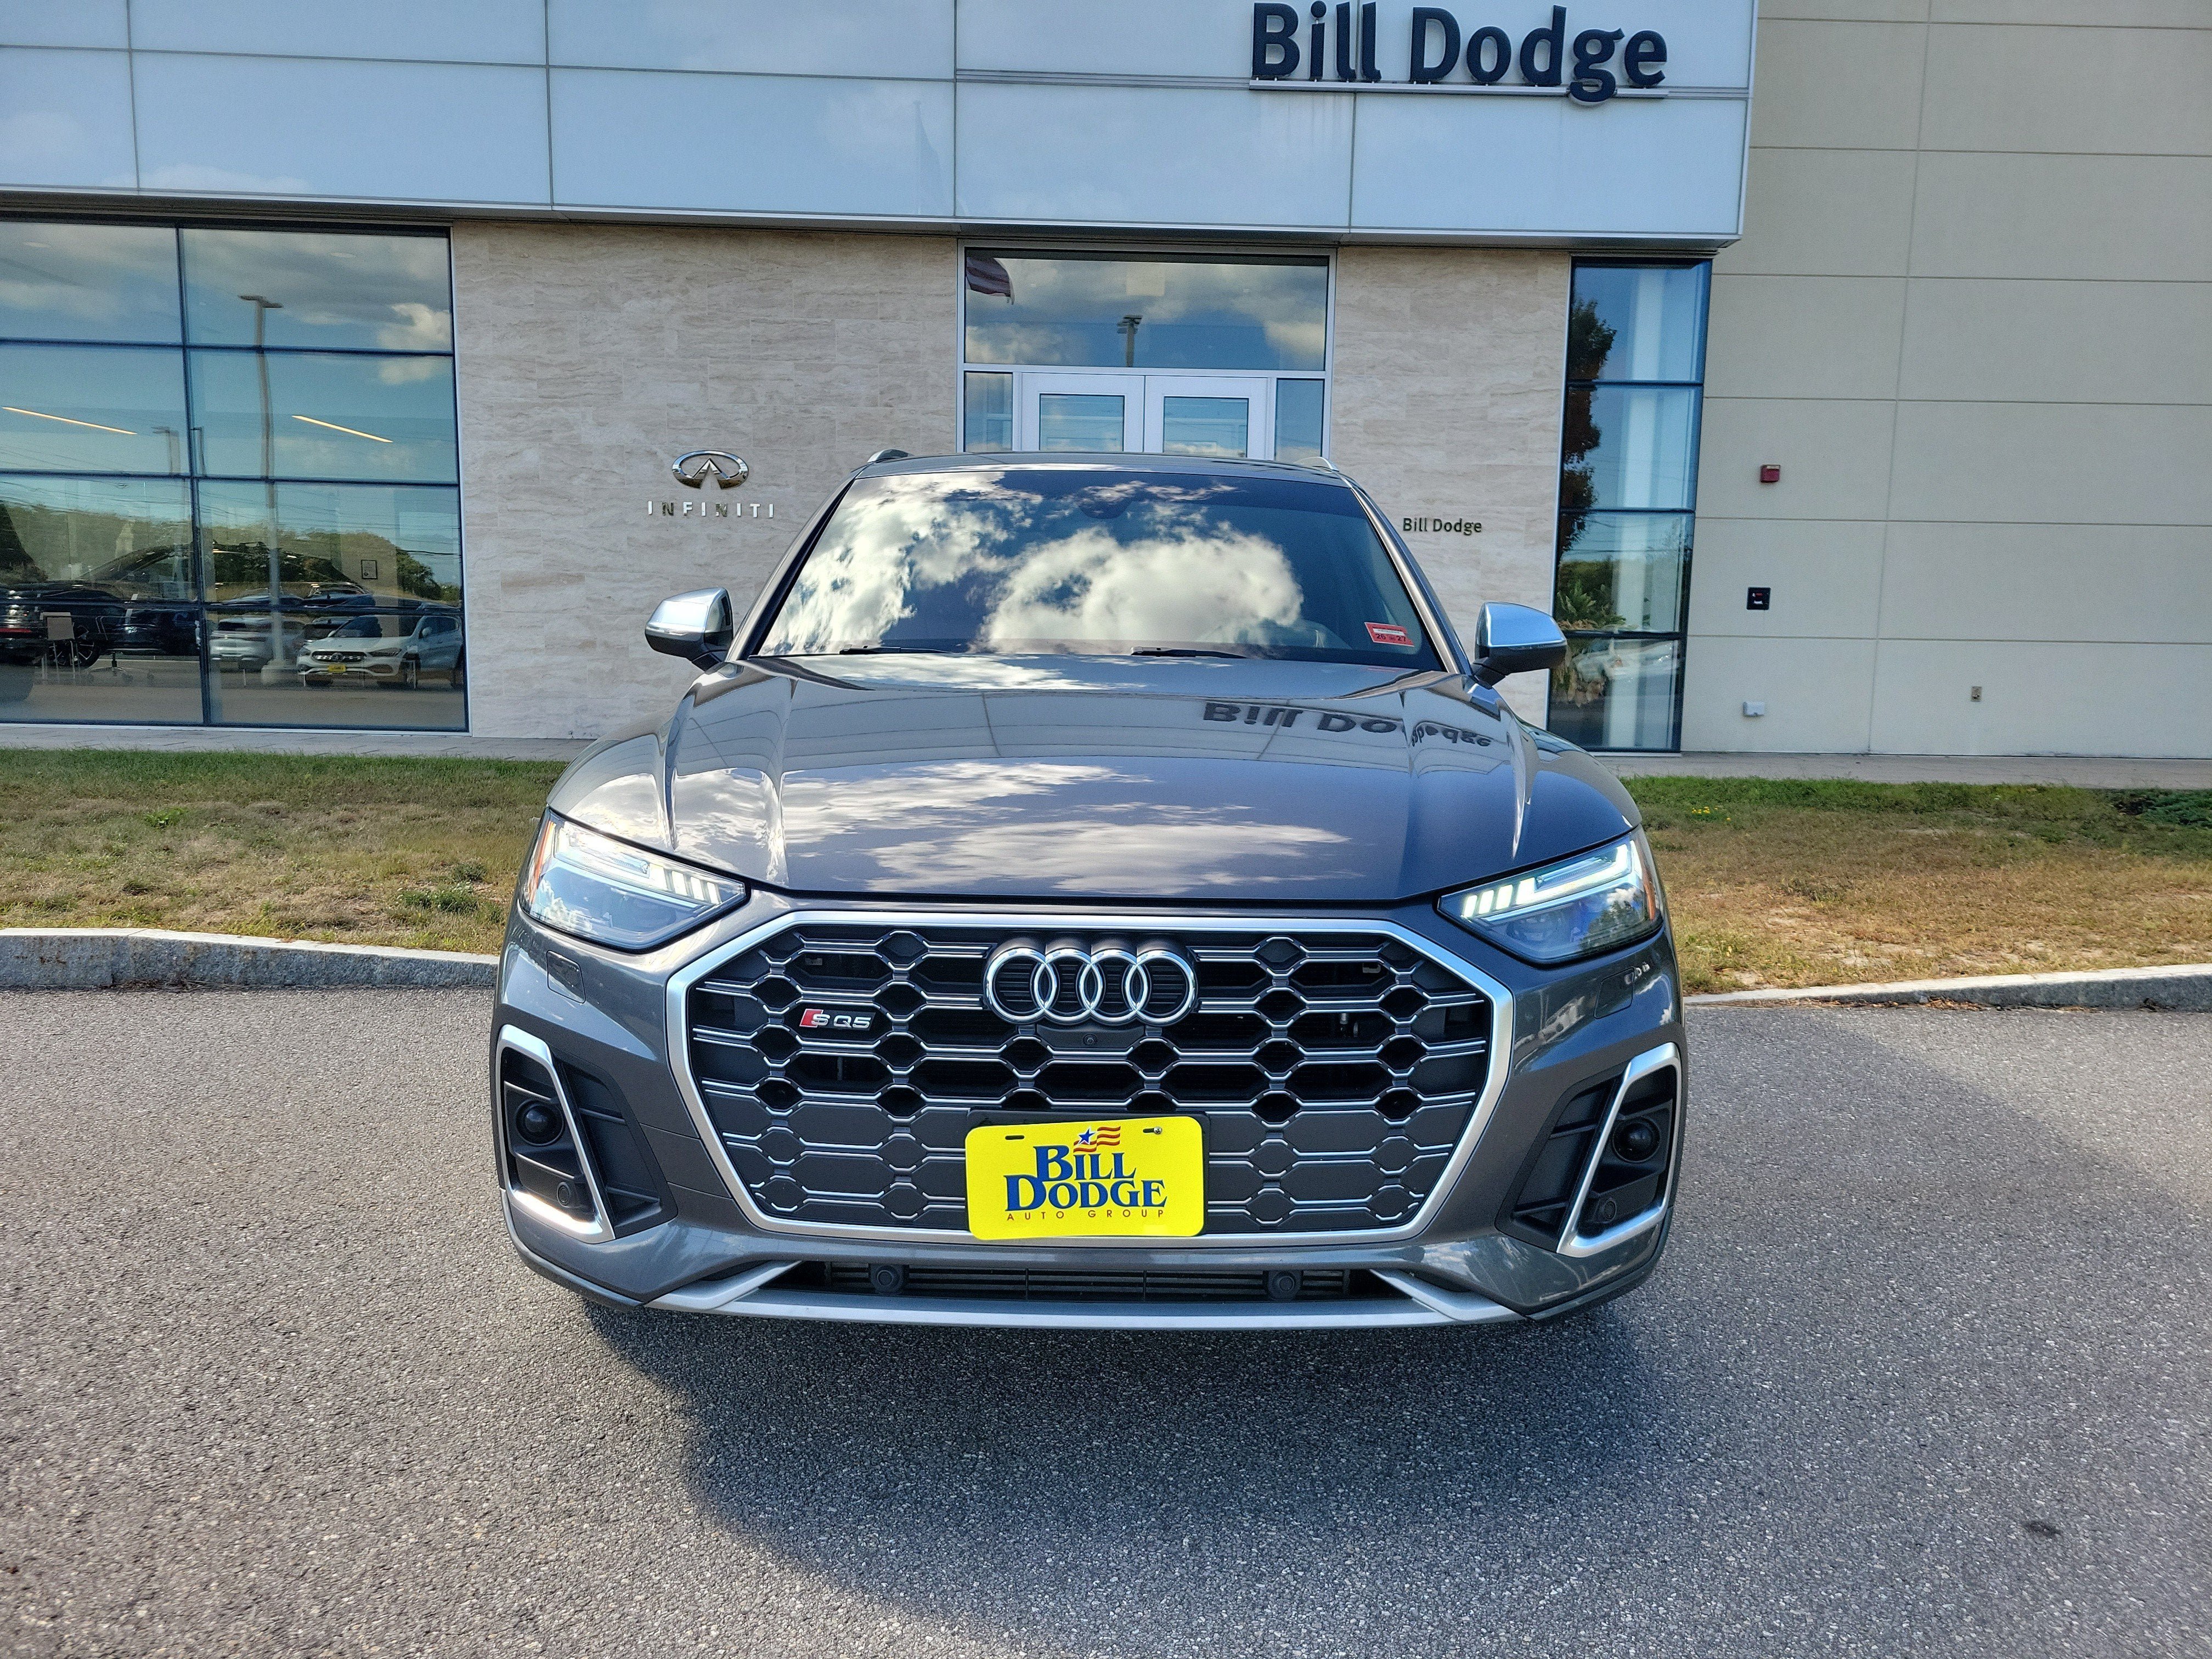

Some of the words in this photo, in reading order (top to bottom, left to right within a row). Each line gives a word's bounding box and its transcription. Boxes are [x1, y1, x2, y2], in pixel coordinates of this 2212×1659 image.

[1252, 1, 1381, 82] Bill
[1410, 4, 1668, 103] Dodge
[647, 500, 774, 518] INFINITI
[1402, 517, 1428, 532] Bill
[1432, 518, 1482, 536] Dodge
[811, 1013, 872, 1029] SQ5
[1007, 1211, 1064, 1221] AUTO
[1088, 1209, 1164, 1219] GROUP
